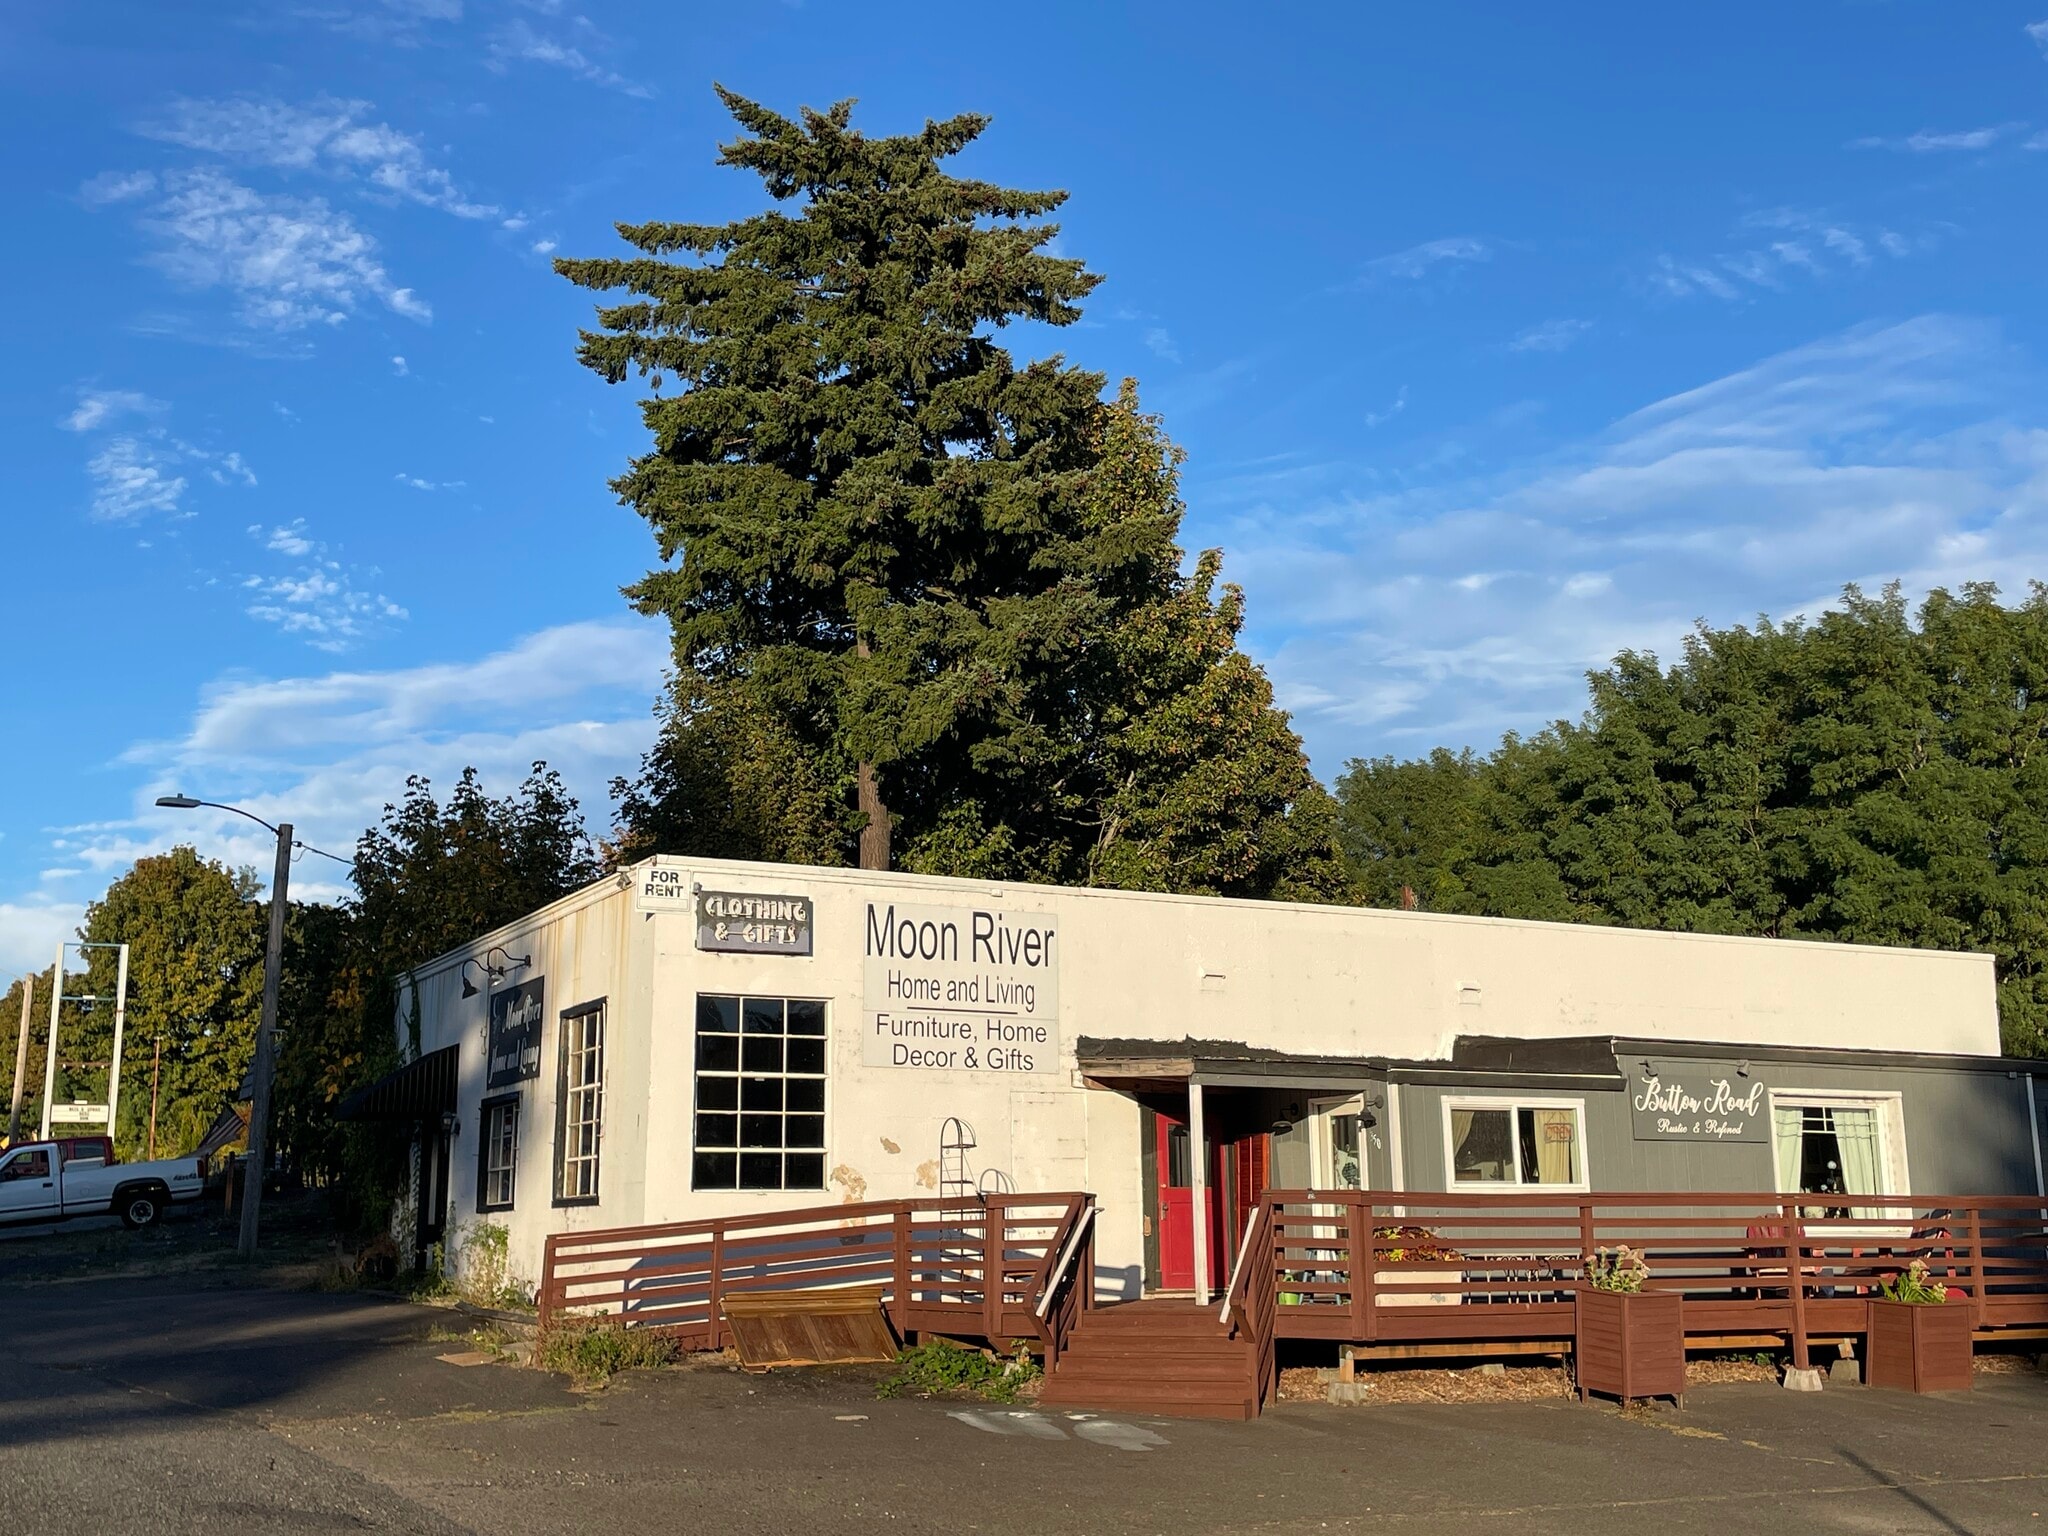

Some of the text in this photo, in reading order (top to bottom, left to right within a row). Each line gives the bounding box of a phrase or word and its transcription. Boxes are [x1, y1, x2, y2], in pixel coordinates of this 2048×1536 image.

[651, 870, 679, 884] FOR
[645, 884, 683, 898] RENT
[705, 896, 808, 922] CLOTHING
[715, 922, 796, 945] & GIFTS
[866, 903, 1055, 967] Moon River
[888, 969, 1036, 1013] Home and Living
[876, 1013, 1047, 1043] Furniture, Home
[893, 1043, 1034, 1071] Decor & Gifts
[1634, 1076, 1764, 1117] Button Road
[1546, 1125, 1572, 1140] OPEN
[1657, 1118, 1744, 1139] Rustic & Refined
